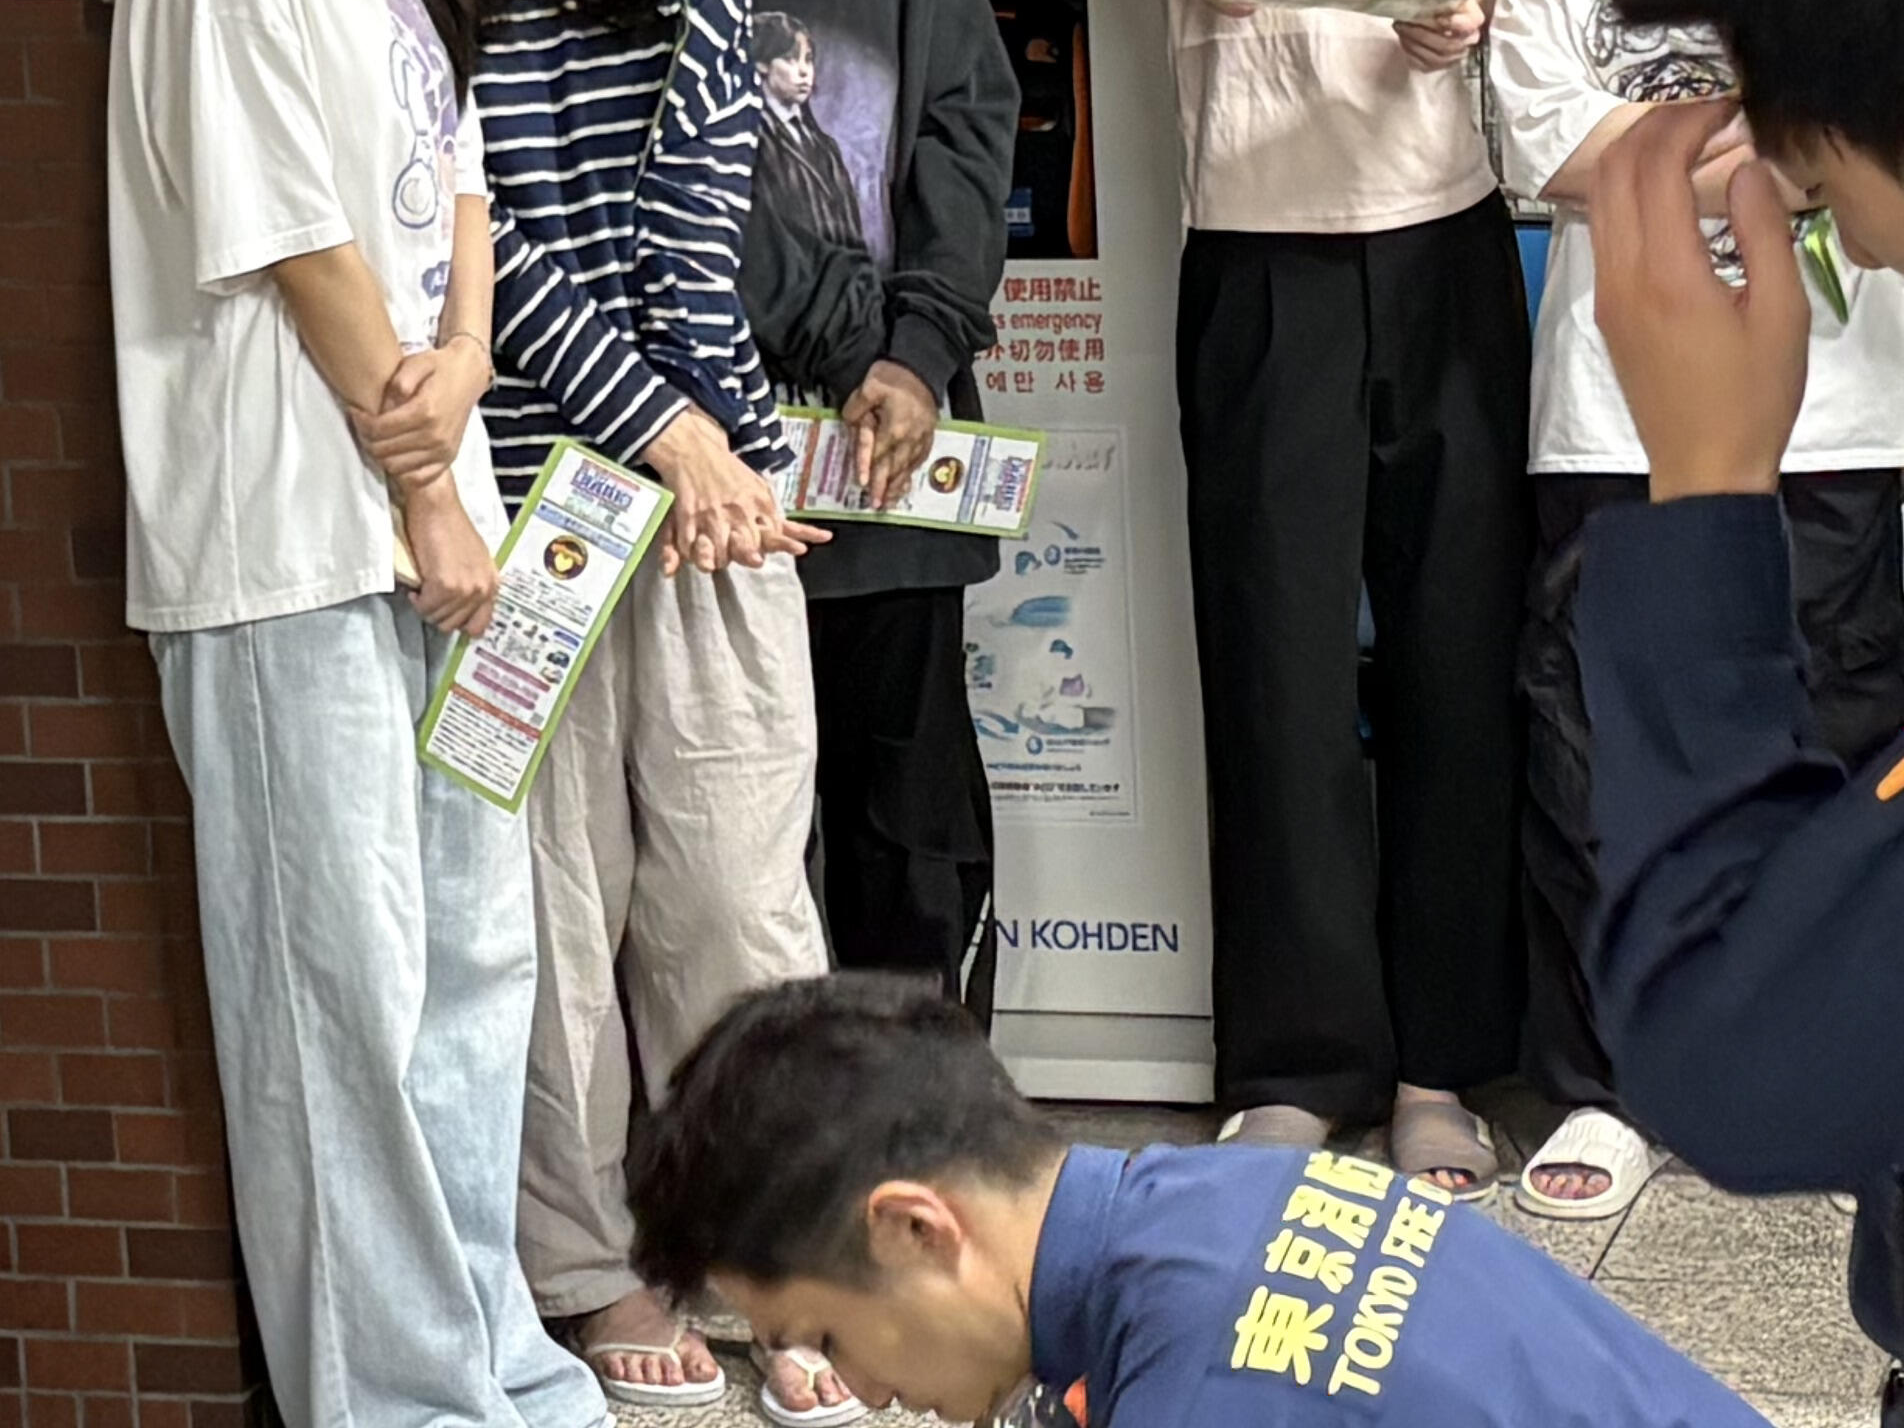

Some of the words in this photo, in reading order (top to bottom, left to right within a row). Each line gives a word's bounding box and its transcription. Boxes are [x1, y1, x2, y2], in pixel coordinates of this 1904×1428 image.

[1004, 277, 1102, 302] 使用禁止
[1010, 313, 1103, 335] emergency
[975, 338, 1104, 362] 外切勿使用
[1056, 370, 1105, 393] 사용
[1030, 919, 1179, 954] KOHDEN
[1328, 1265, 1418, 1396] TOKYO
[1380, 1196, 1447, 1268] FIRE
